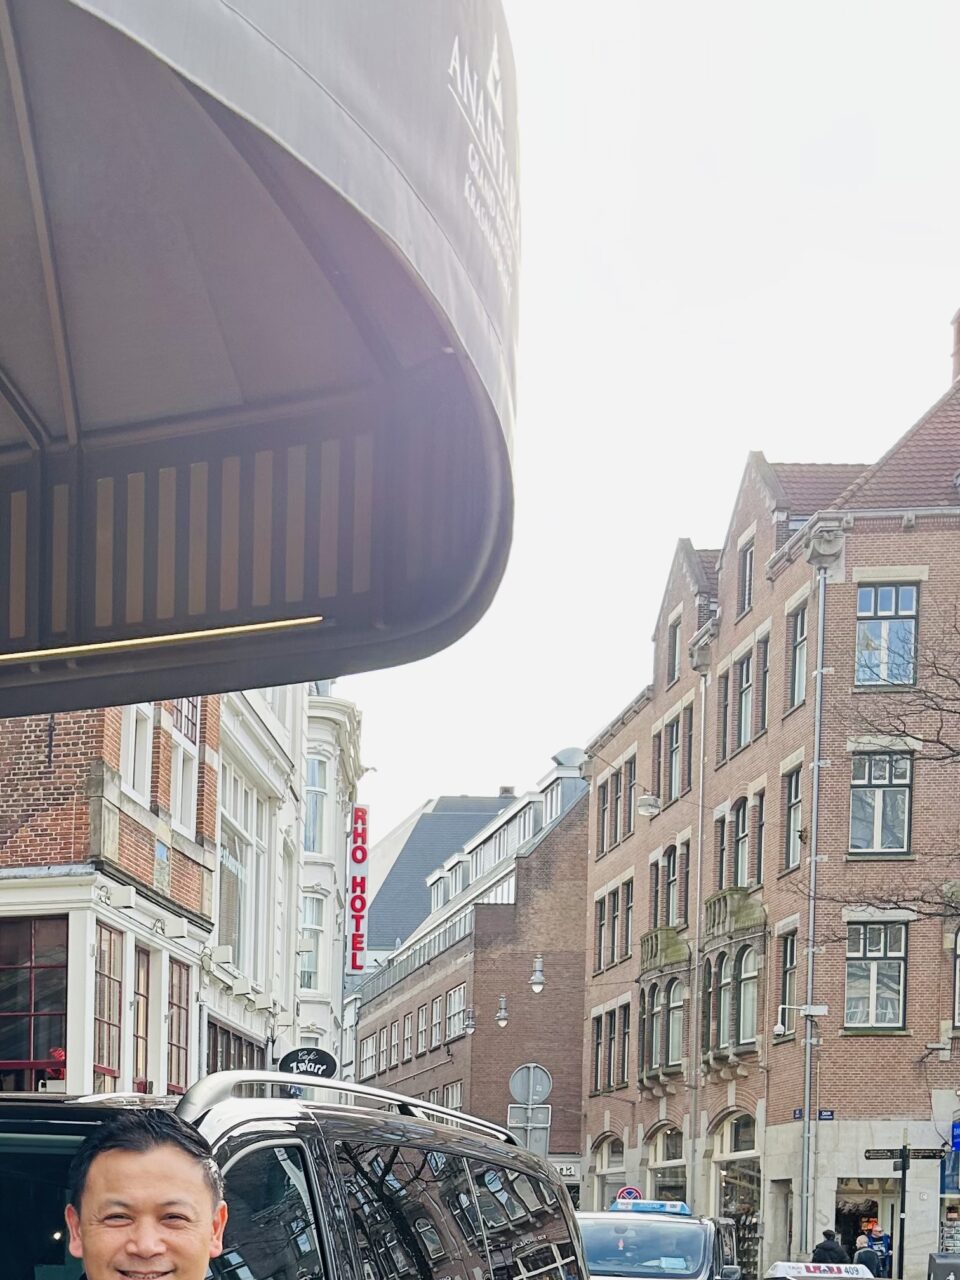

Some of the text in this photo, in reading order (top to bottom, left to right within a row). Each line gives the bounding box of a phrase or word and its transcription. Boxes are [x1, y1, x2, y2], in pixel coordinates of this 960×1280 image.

[350, 807, 368, 971] RHO HOTEL
[844, 1266, 859, 1275] 409
